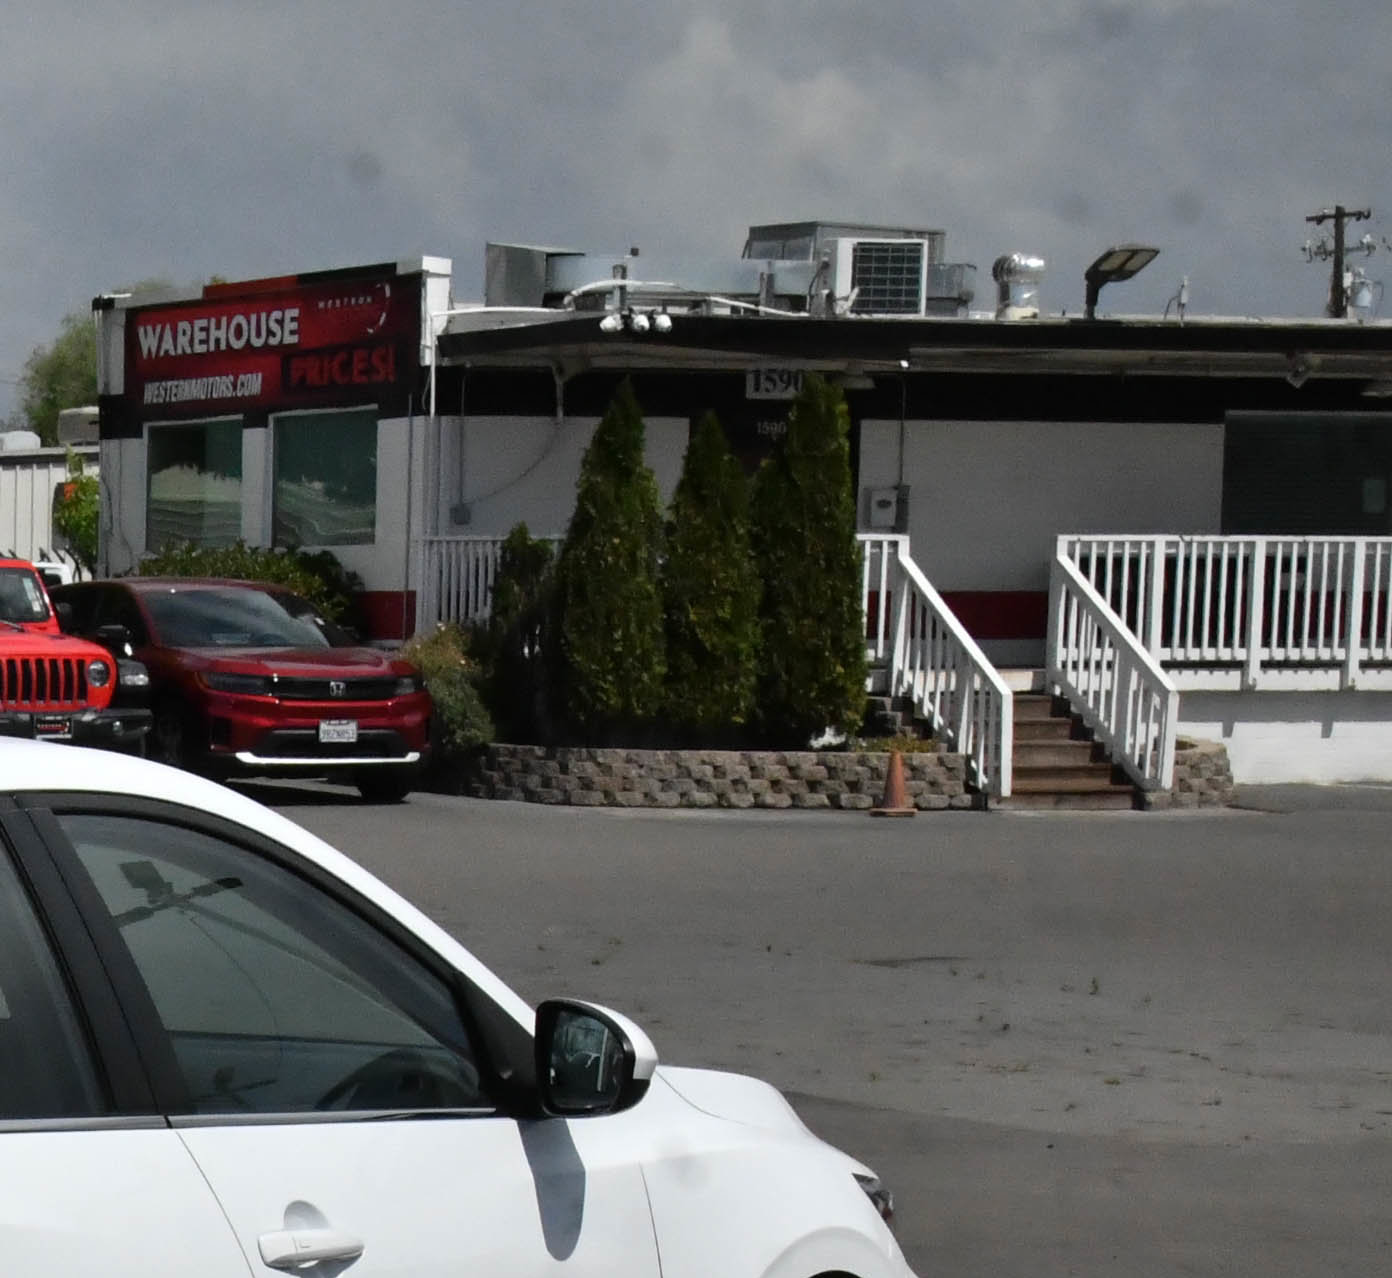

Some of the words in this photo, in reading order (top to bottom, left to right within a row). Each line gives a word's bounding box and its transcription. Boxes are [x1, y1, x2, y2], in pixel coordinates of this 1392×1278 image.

[138, 308, 300, 360] WAREHOUSE
[290, 343, 396, 387] PRICES!
[143, 372, 263, 405] WESTERNMOTORS.COM
